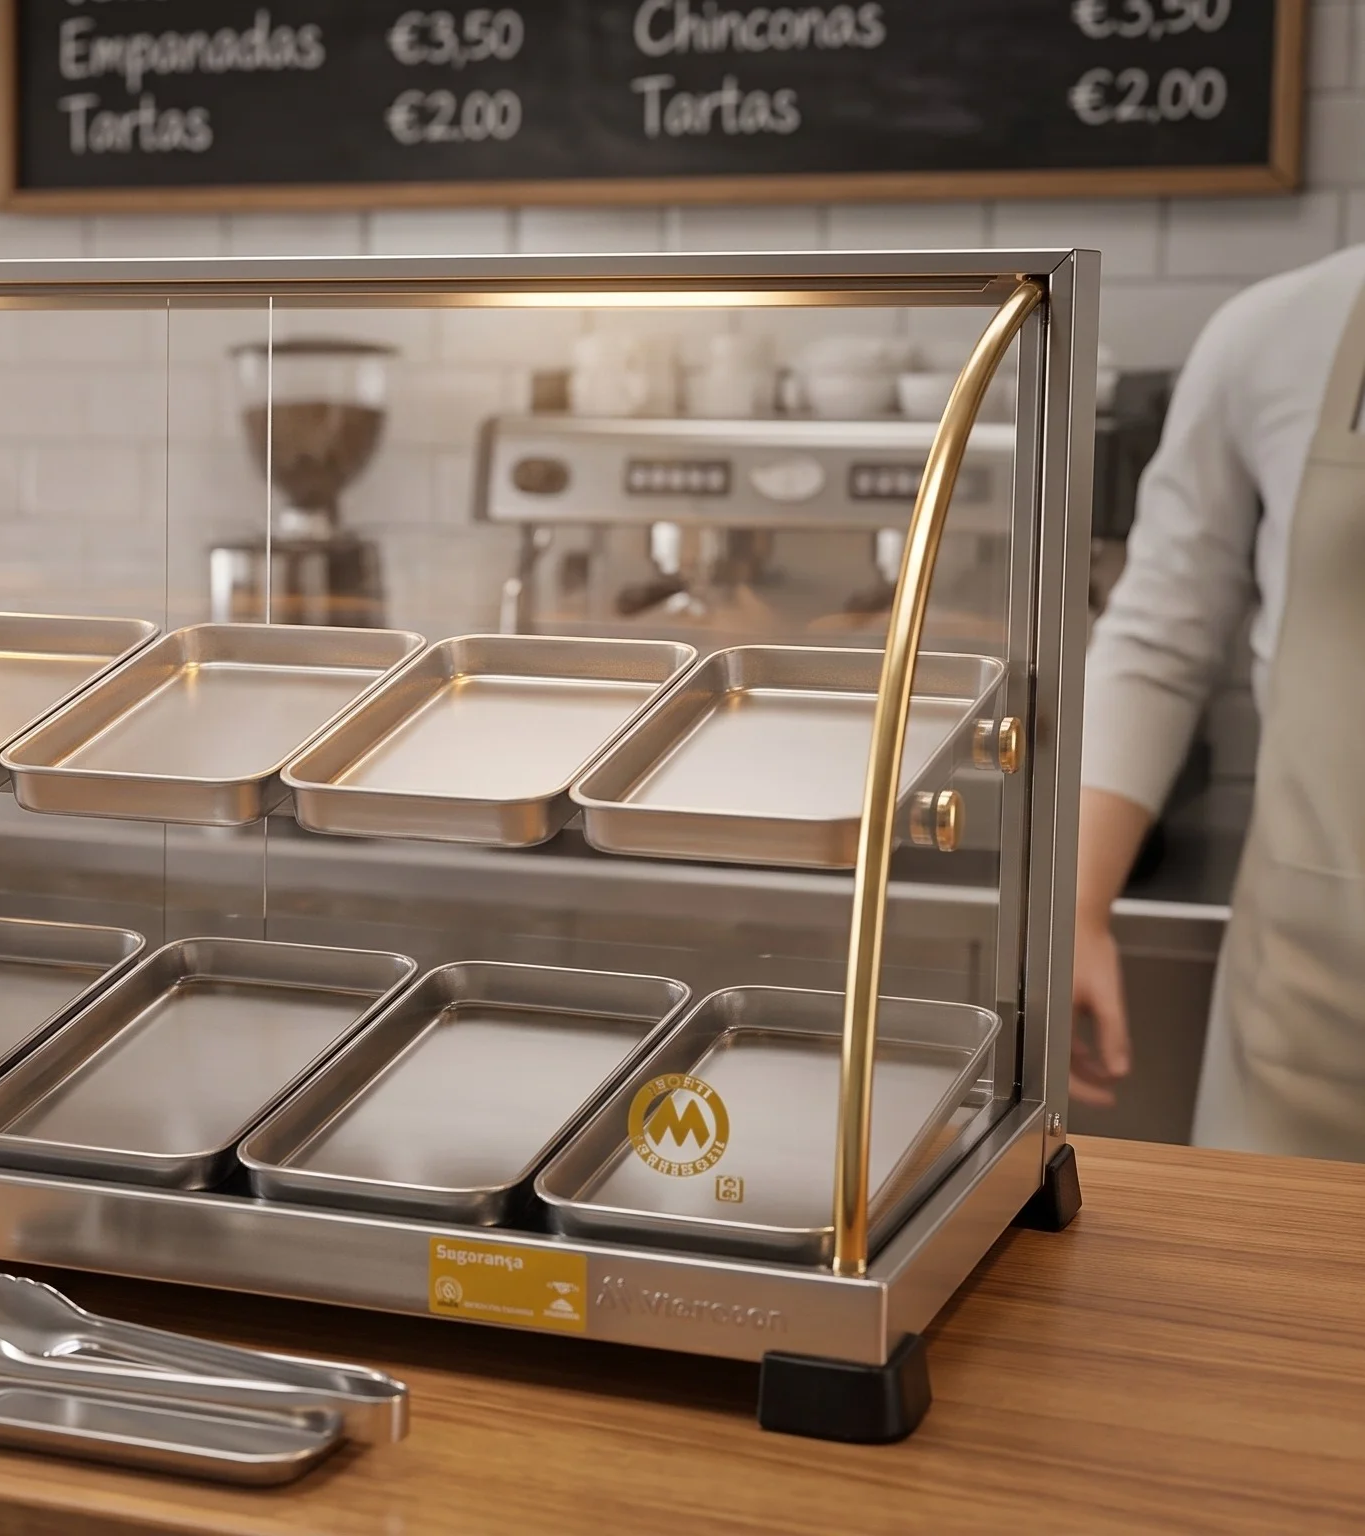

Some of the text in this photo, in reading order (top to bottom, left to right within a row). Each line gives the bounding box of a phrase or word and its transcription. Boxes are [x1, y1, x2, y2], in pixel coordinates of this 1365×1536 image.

[59, 8, 524, 92] Empanadas €3,50
[633, 0, 887, 57] Chinconas
[58, 92, 213, 155] Tartas
[630, 73, 802, 139] Tartas
